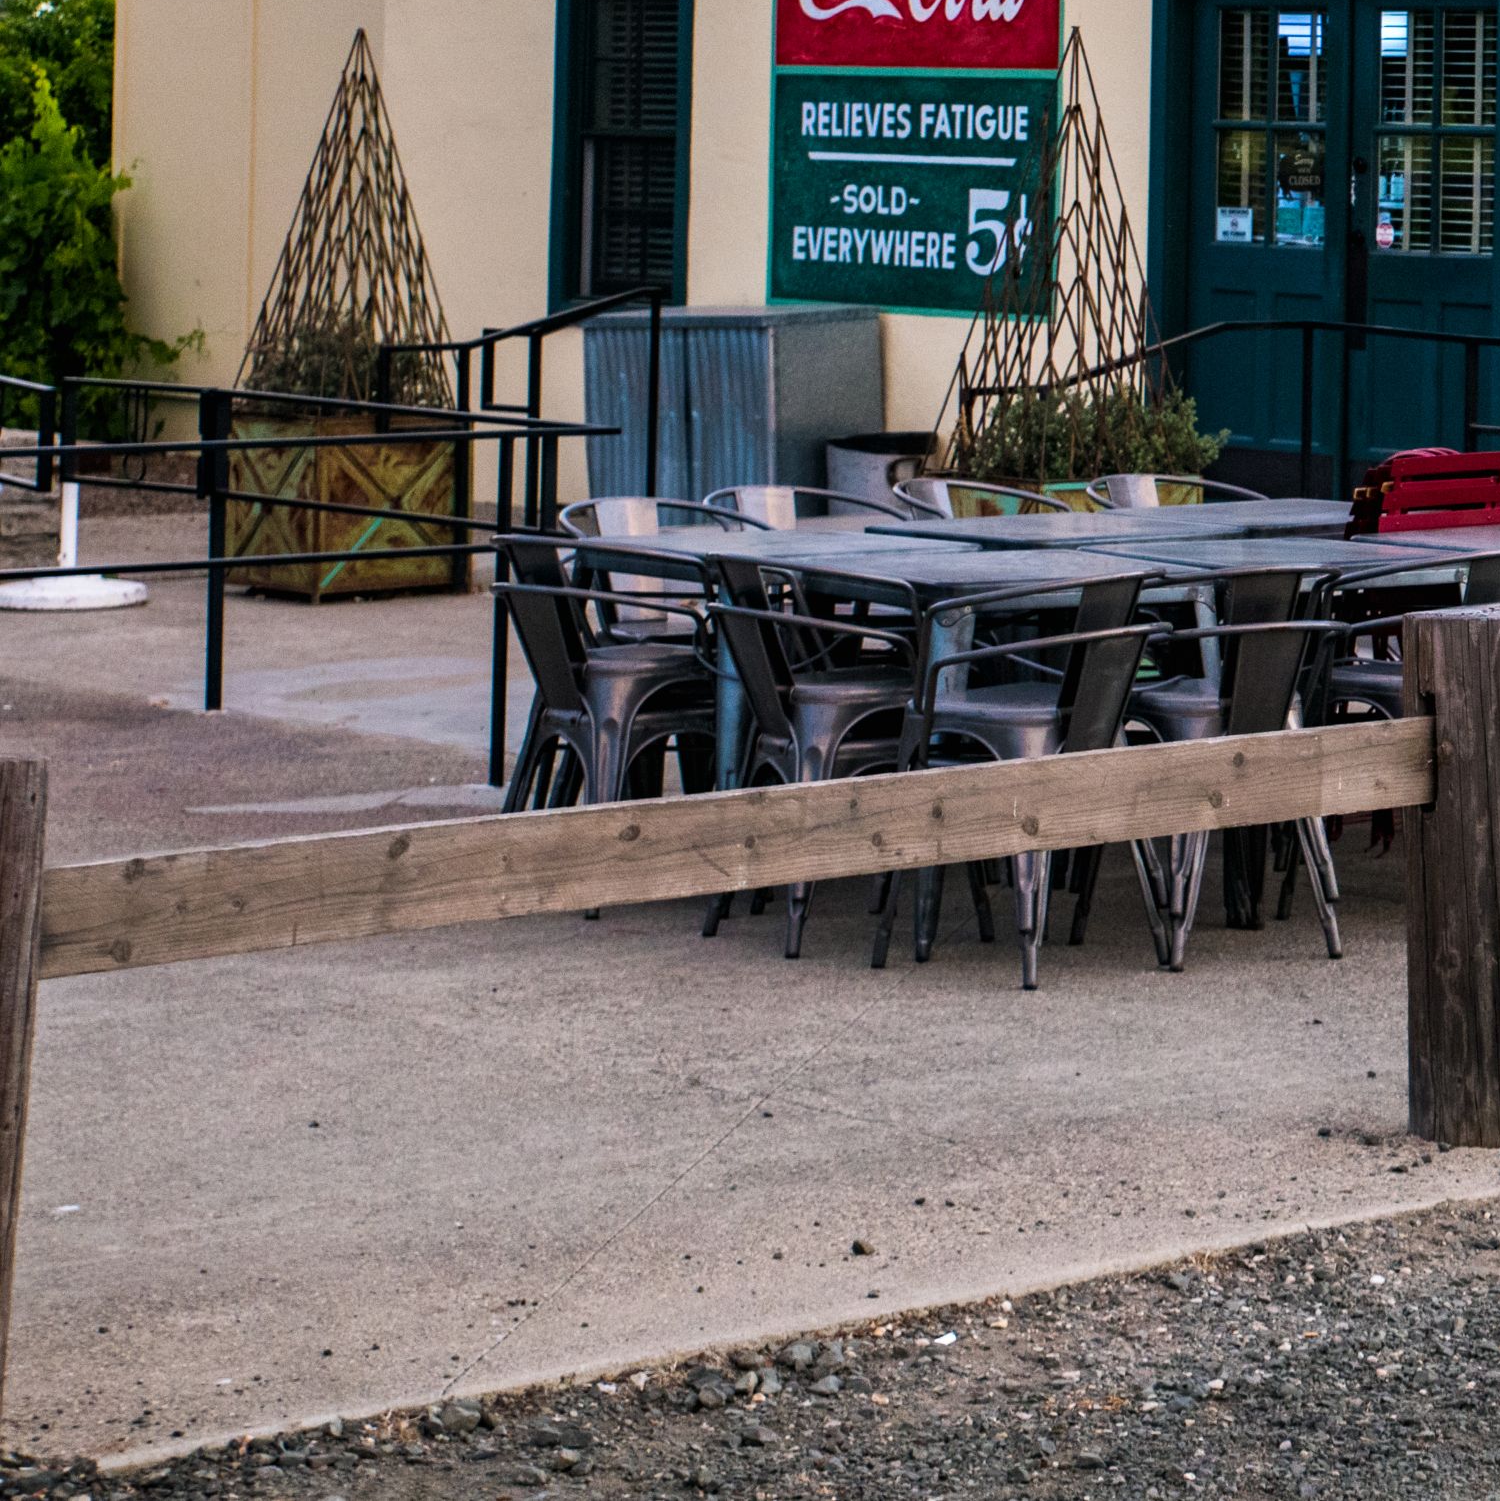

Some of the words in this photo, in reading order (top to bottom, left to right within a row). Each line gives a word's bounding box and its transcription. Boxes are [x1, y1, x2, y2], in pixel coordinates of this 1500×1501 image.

[801, 101, 911, 138] RELIEVES
[919, 103, 1028, 142] FATIGUE
[1288, 175, 1321, 186] CLOSED
[791, 225, 956, 270] EVERYWHERE
